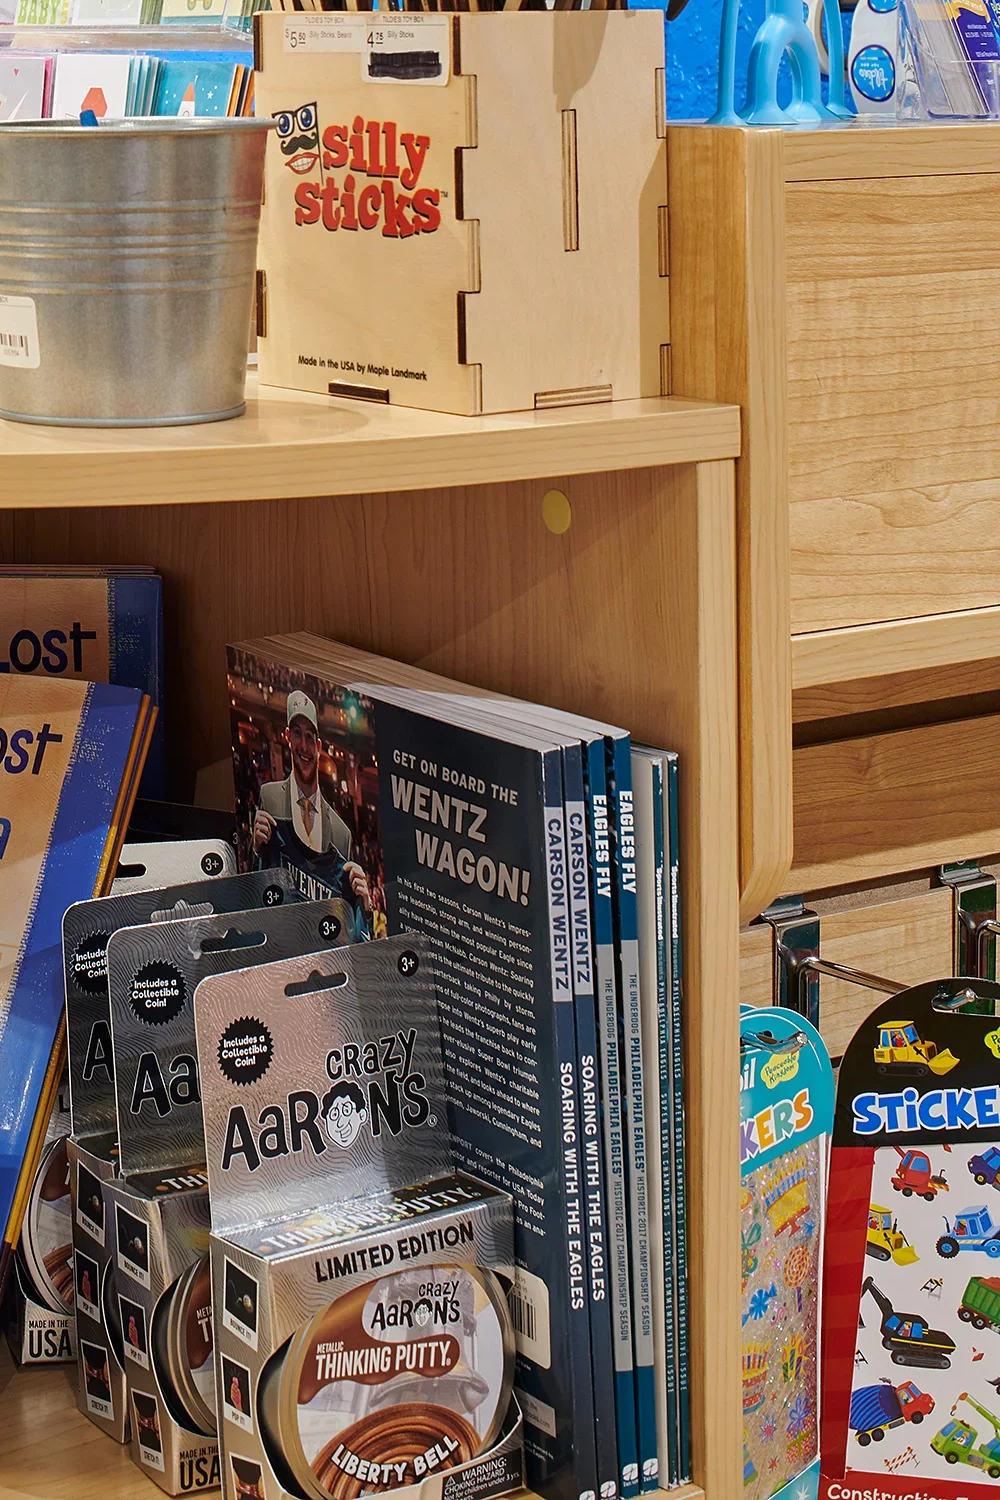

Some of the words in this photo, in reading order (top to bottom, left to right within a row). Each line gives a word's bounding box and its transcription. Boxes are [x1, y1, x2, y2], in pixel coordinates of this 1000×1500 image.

[387, 30, 398, 39] Silly
[399, 30, 415, 38] Sticks
[298, 355, 318, 367] Made
[319, 357, 326, 367] in
[327, 359, 339, 369] the
[340, 361, 355, 372] USA
[356, 362, 366, 375] by
[367, 364, 390, 377] Maple
[391, 367, 428, 381] Landmark
[393, 749, 416, 770] GET
[420, 759, 438, 779] ON
[442, 766, 487, 795] BOARD
[490, 783, 518, 806] THE
[390, 773, 488, 844] WENTZ
[619, 790, 636, 859] EAGLES
[415, 828, 531, 907] WAGON!
[547, 818, 565, 907] CARSON
[622, 862, 637, 894] FLY
[462, 903, 482, 919] Carson
[483, 912, 506, 929] Wentz's
[401, 955, 416, 972] 3+
[552, 915, 570, 991] WENTZ
[132, 987, 180, 1000] Collectible
[134, 979, 169, 990] Includes
[510, 970, 534, 988] Soaring
[629, 974, 637, 989] THE
[145, 997, 167, 1008] Coin!
[630, 991, 640, 1034] UNDERDOG
[477, 1048, 494, 1063] Super
[496, 1057, 511, 1071] Bowl
[630, 1037, 643, 1124] PHILADELPHIA
[560, 1062, 577, 1144] SOARING
[634, 1127, 646, 1173] EAGLES'
[563, 1149, 579, 1194] WITH
[636, 1176, 646, 1218] HISTORIC
[566, 1199, 581, 1235] THE
[638, 1219, 647, 1239] 2017
[315, 1244, 394, 1283] LIMITED
[397, 1220, 475, 1260] EDITION
[568, 1239, 584, 1311] EAGLES
[639, 1240, 650, 1303] CHAMPIONSHIP
[28, 1320, 47, 1329] MADE
[48, 1320, 55, 1328] IN
[56, 1319, 69, 1328] THE
[641, 1305, 650, 1336] SEASON
[28, 1330, 73, 1358] USA
[316, 1341, 345, 1354] METALLIC
[315, 1347, 391, 1380] THINKING
[330, 1443, 408, 1485] LIBERTY
[412, 1435, 461, 1476] BELL
[461, 1456, 508, 1480] WARNING:
